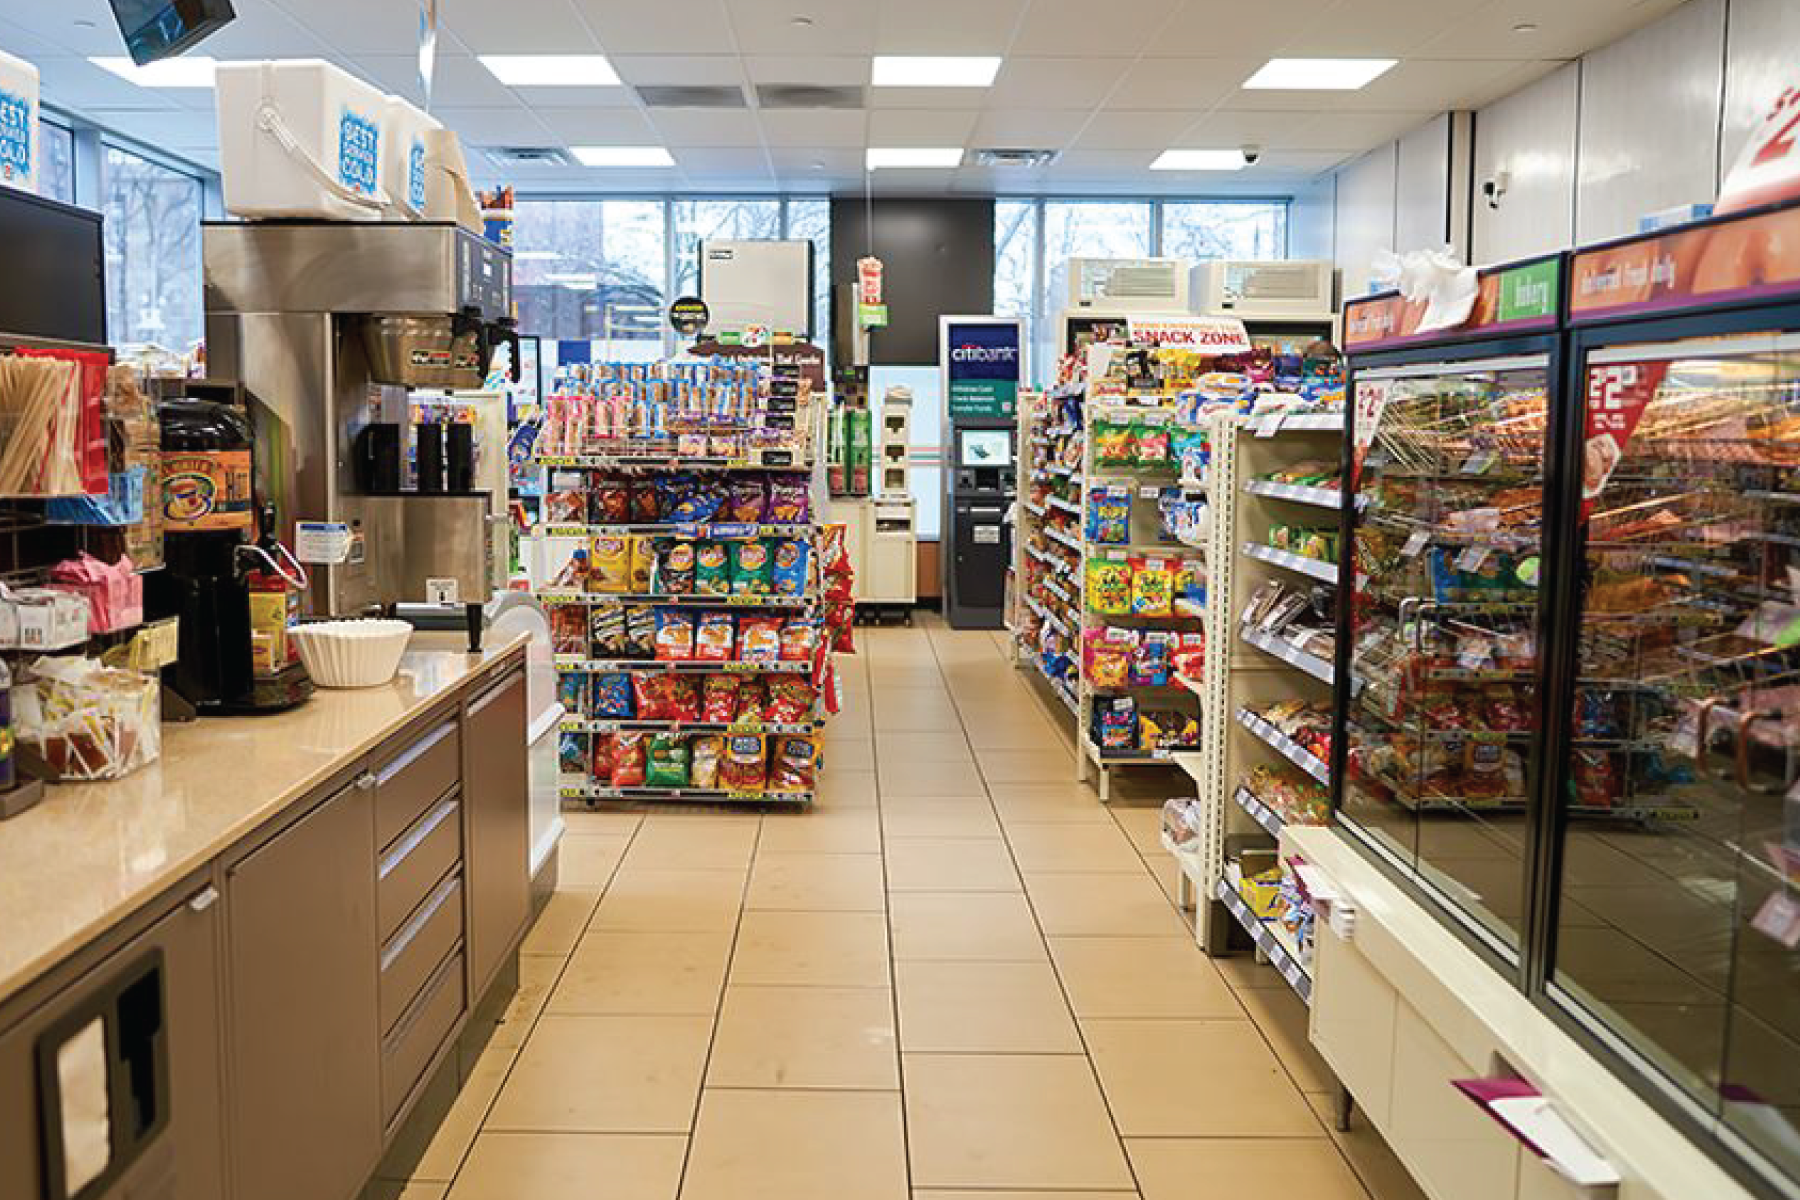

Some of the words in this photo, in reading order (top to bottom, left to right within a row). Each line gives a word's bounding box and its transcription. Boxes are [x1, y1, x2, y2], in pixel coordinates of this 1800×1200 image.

[0, 101, 25, 127] EST
[0, 138, 26, 161] OLD
[1132, 331, 1196, 345] SNACK
[1199, 331, 1246, 345] ZONE
[953, 345, 1015, 362] citibank
